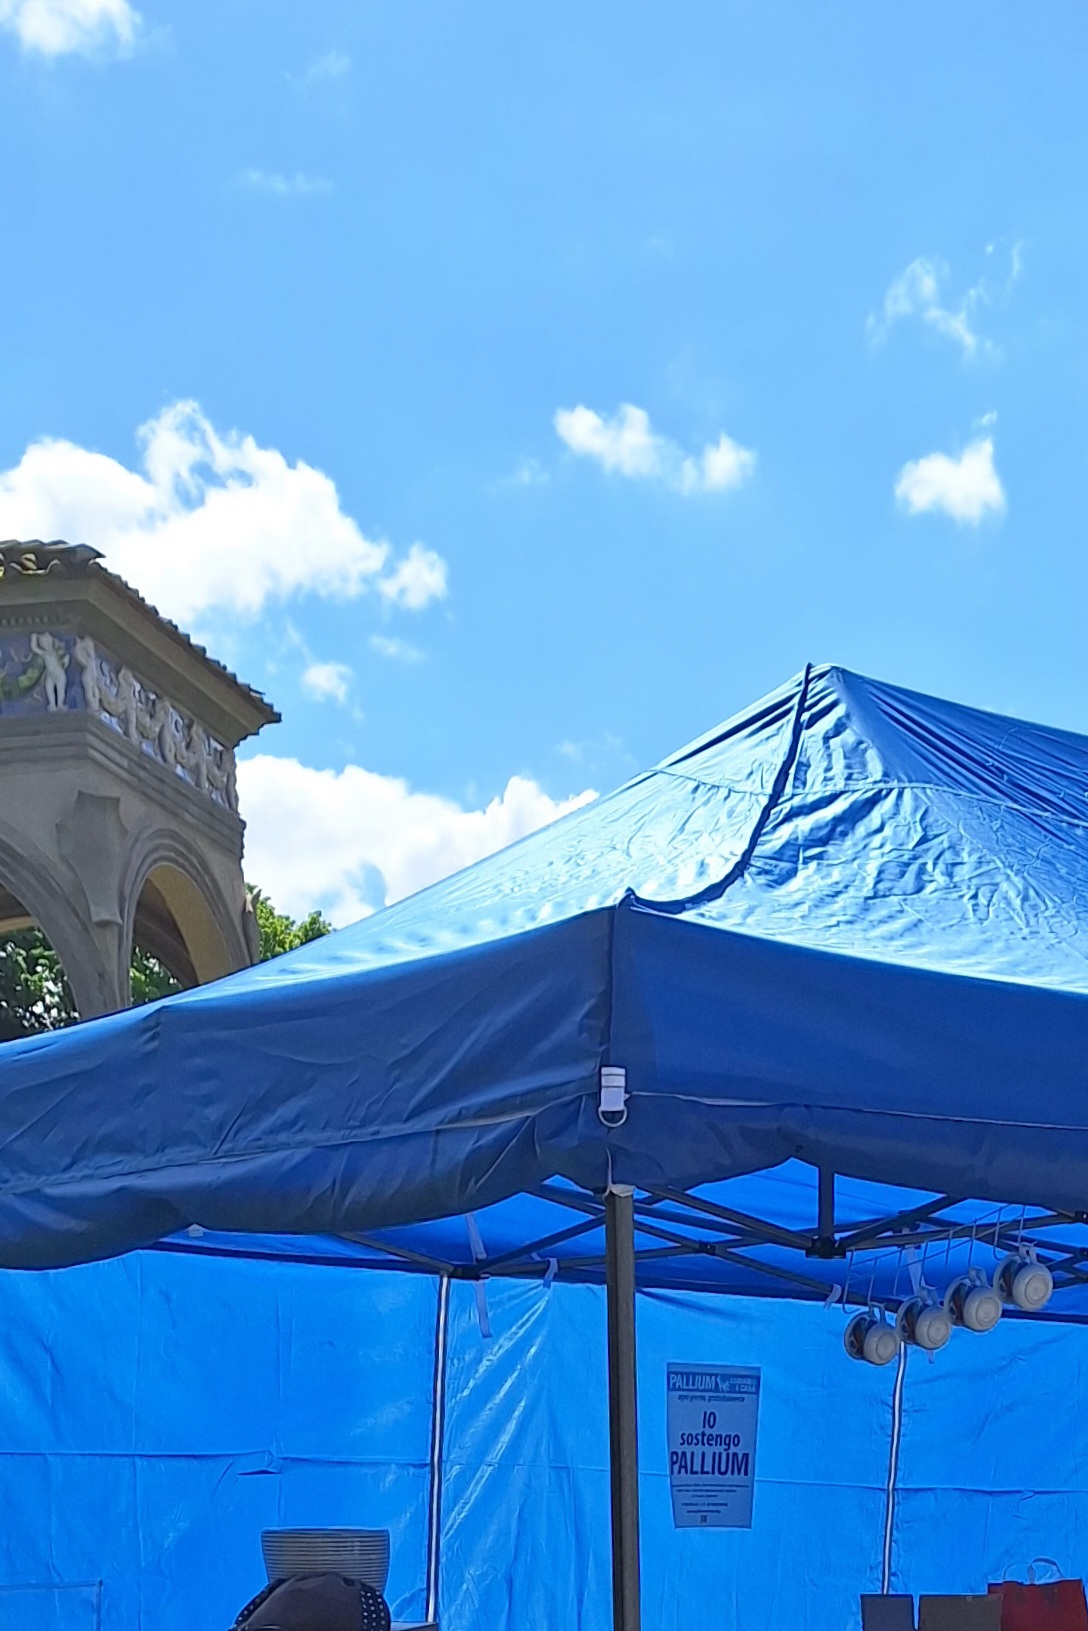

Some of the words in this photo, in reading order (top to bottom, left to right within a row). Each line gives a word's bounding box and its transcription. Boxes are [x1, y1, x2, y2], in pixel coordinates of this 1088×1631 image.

[669, 1374, 715, 1390] PALLIUM
[702, 1411, 717, 1429] IO
[680, 1430, 741, 1451] sostengo
[670, 1451, 749, 1476] PALLIUM
